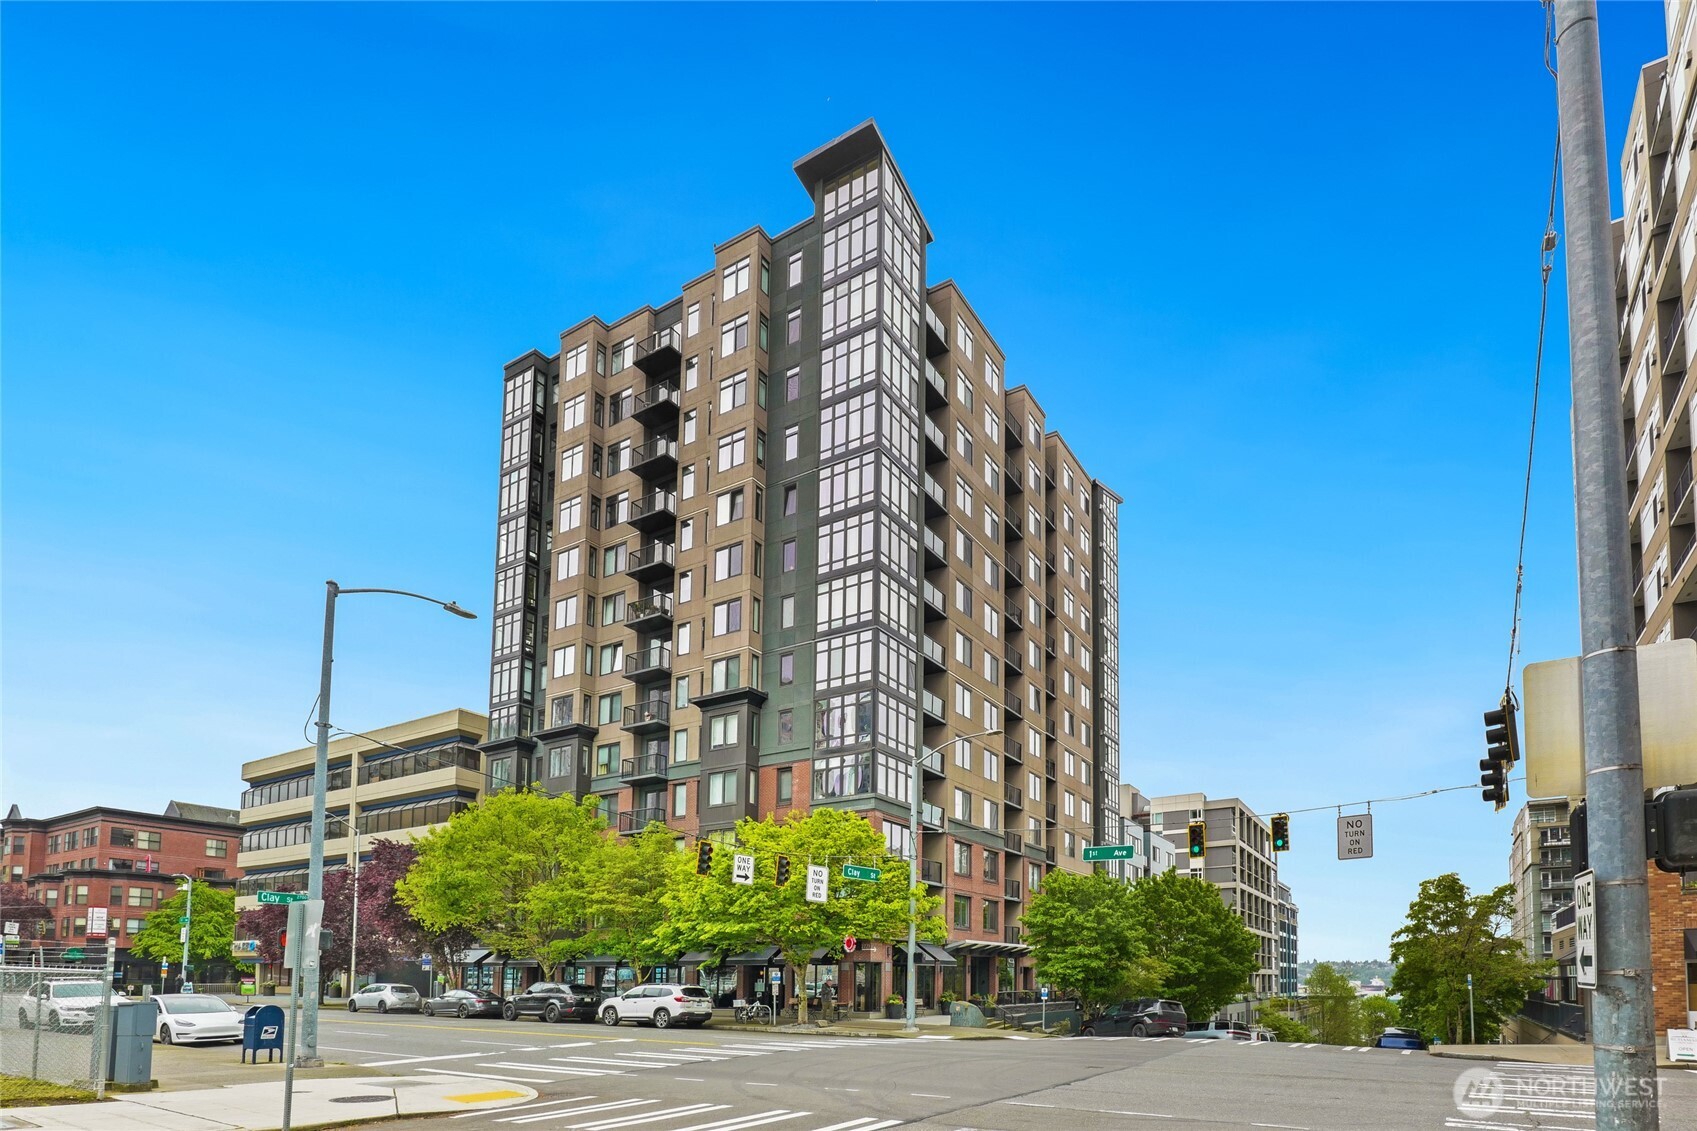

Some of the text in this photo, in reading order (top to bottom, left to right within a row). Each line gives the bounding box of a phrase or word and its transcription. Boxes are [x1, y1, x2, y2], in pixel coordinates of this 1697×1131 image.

[1346, 820, 1363, 829] NO
[1345, 830, 1365, 838] TURN
[1089, 849, 1127, 858] 1st Ave
[1348, 847, 1363, 855] RED
[737, 856, 751, 865] ONE
[736, 864, 751, 873] WAY
[812, 869, 823, 877] NO
[847, 867, 860, 878] Clay
[811, 877, 824, 885] TURN
[261, 892, 280, 904] Clay
[1577, 881, 1591, 910] ONE
[1578, 913, 1592, 941] WAY
